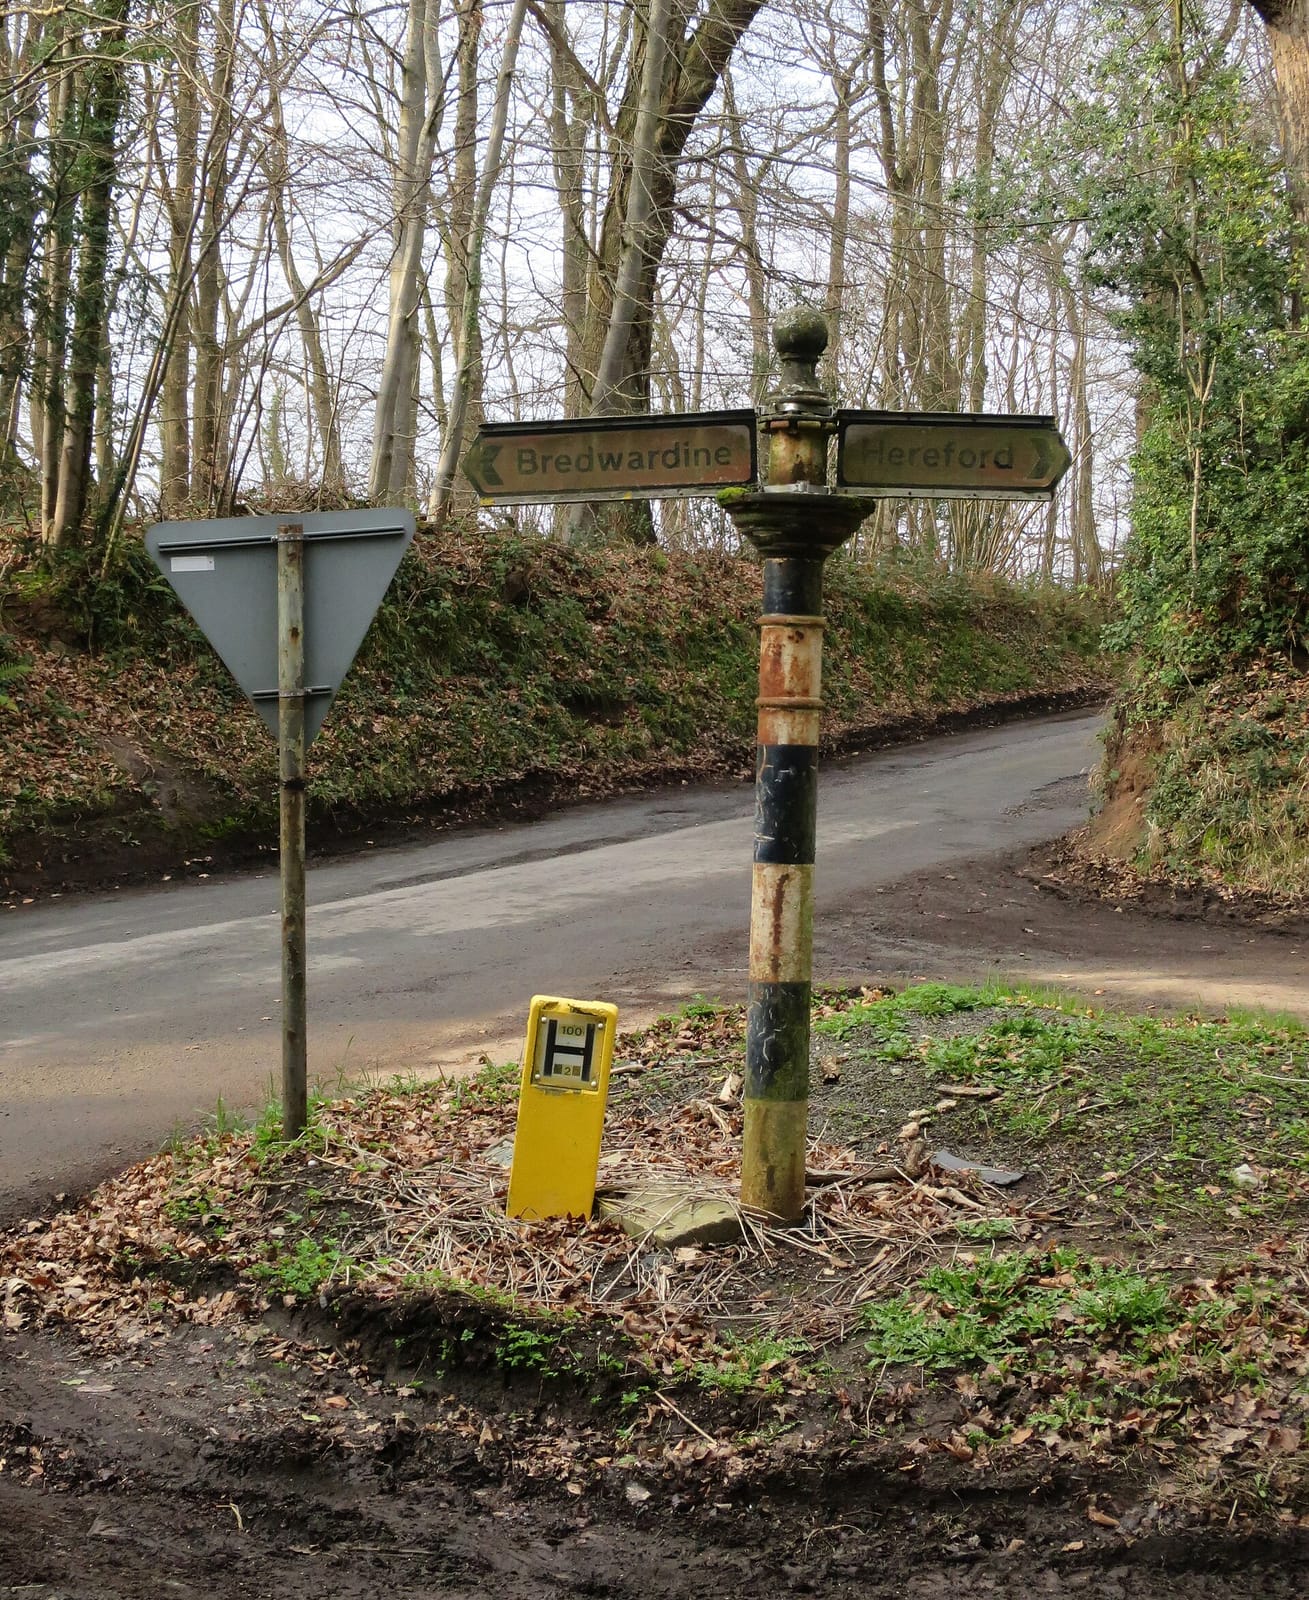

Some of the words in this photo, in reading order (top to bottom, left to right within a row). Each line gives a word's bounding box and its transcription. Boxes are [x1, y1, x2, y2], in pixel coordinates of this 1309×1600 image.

[517, 441, 731, 475] Bredwardine
[861, 440, 1014, 469] Hereford
[562, 1026, 582, 1036] 100
[544, 1019, 595, 1081] H
[563, 1067, 572, 1076] 2
